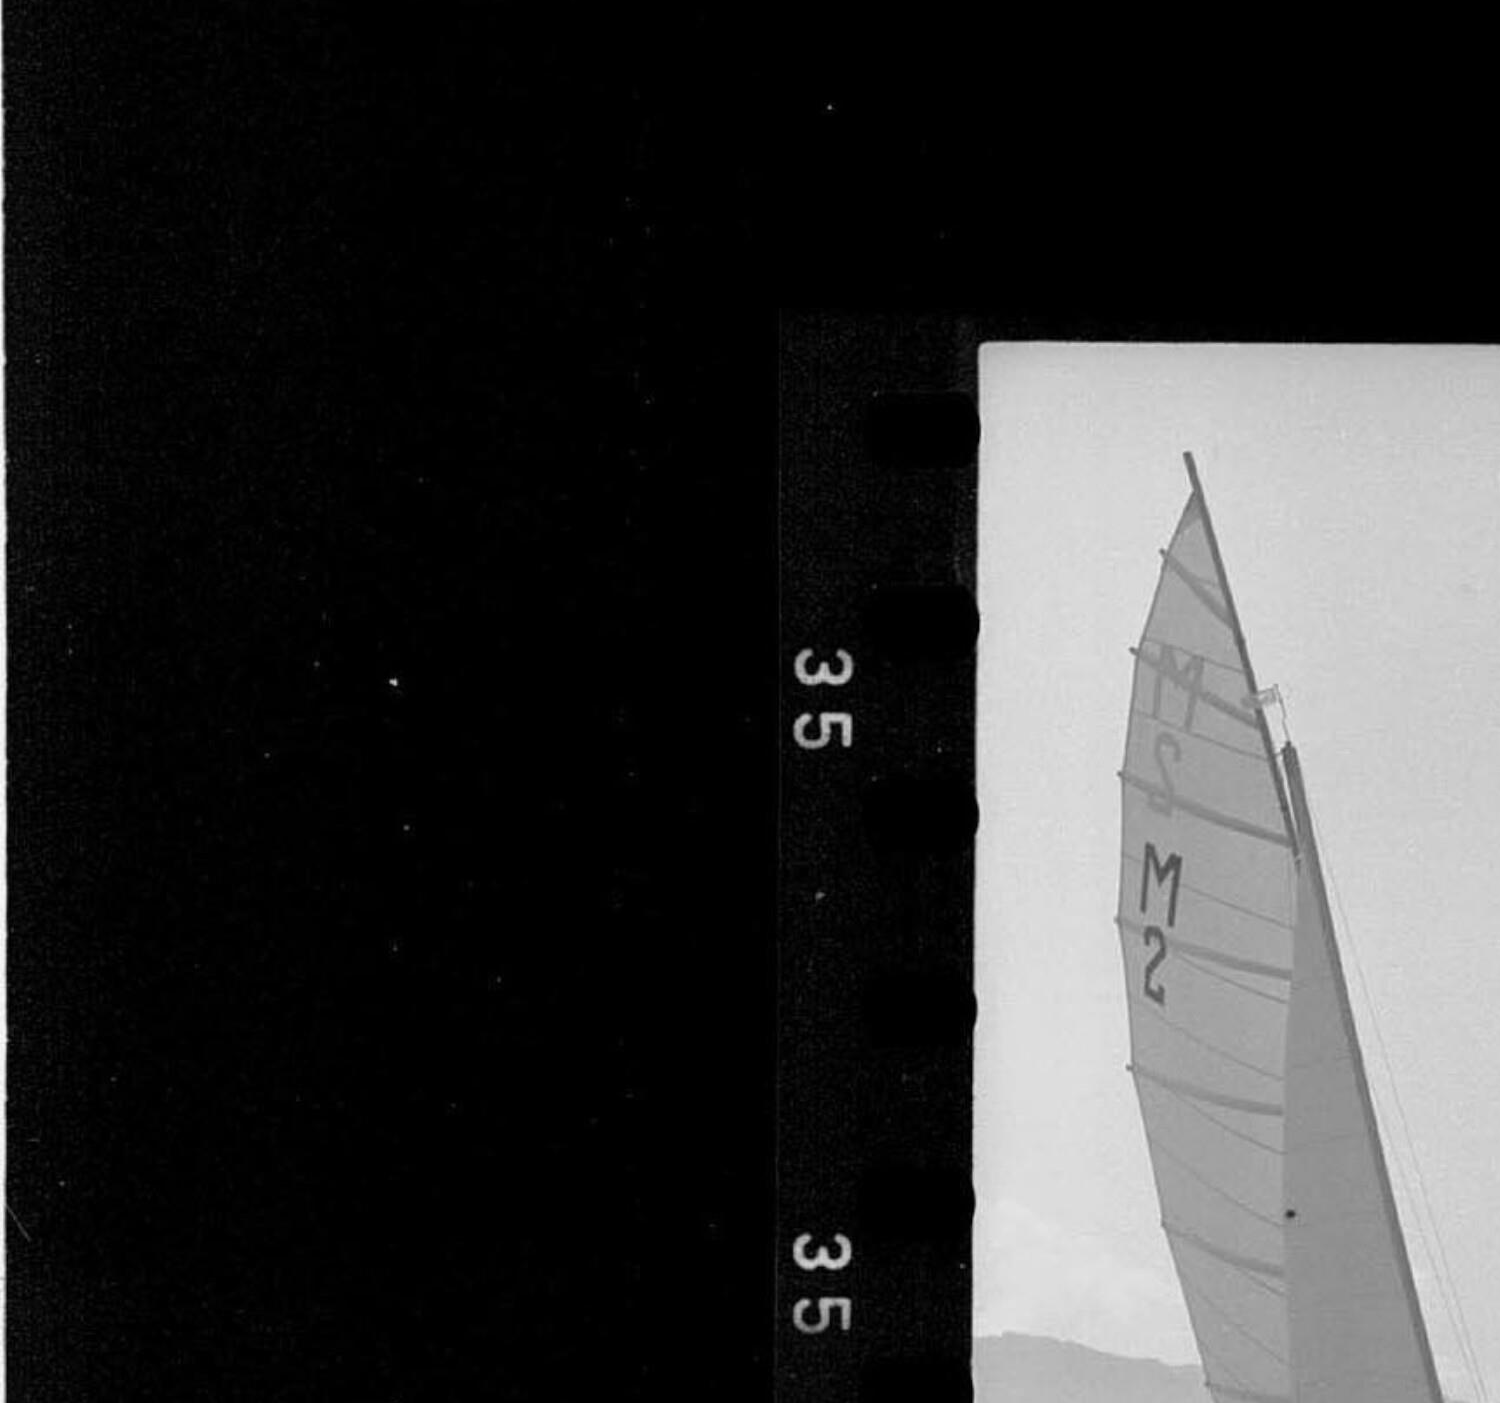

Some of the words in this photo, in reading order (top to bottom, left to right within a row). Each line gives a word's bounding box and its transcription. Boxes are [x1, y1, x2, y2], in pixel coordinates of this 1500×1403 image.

[792, 647, 855, 750] 35
[1140, 842, 1183, 928] M
[1143, 925, 1167, 1006] 2
[791, 1231, 853, 1335] 35
